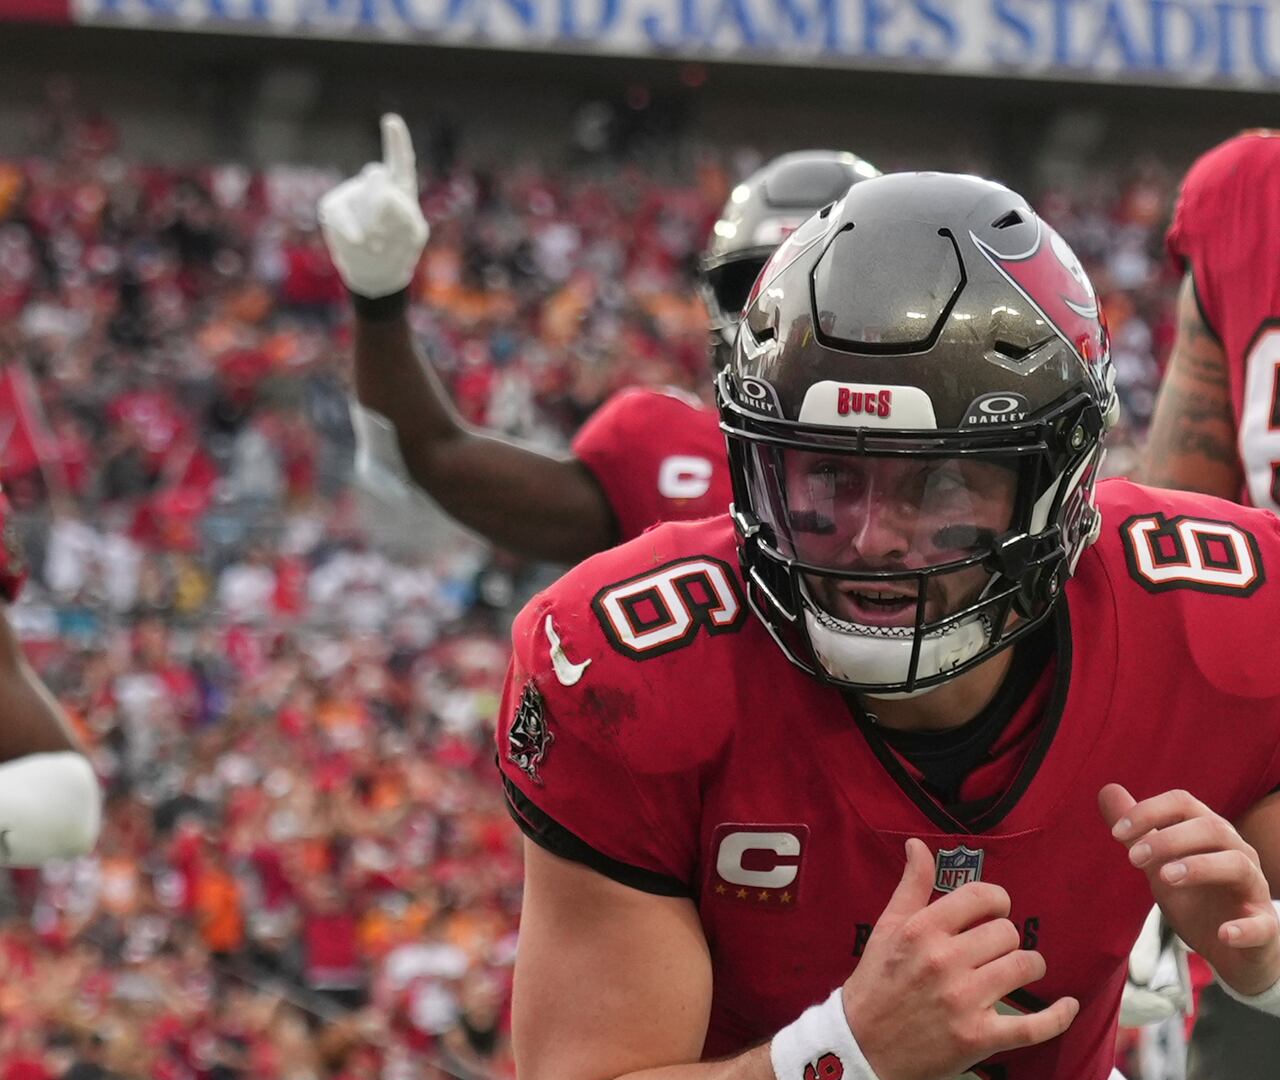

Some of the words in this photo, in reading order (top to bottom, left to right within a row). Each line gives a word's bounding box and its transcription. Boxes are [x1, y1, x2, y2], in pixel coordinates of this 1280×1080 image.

[968, 411, 1027, 425] OAKLEY
[657, 455, 714, 498] C
[1120, 512, 1268, 598] 6
[591, 554, 748, 662] 6
[716, 831, 800, 889] C
